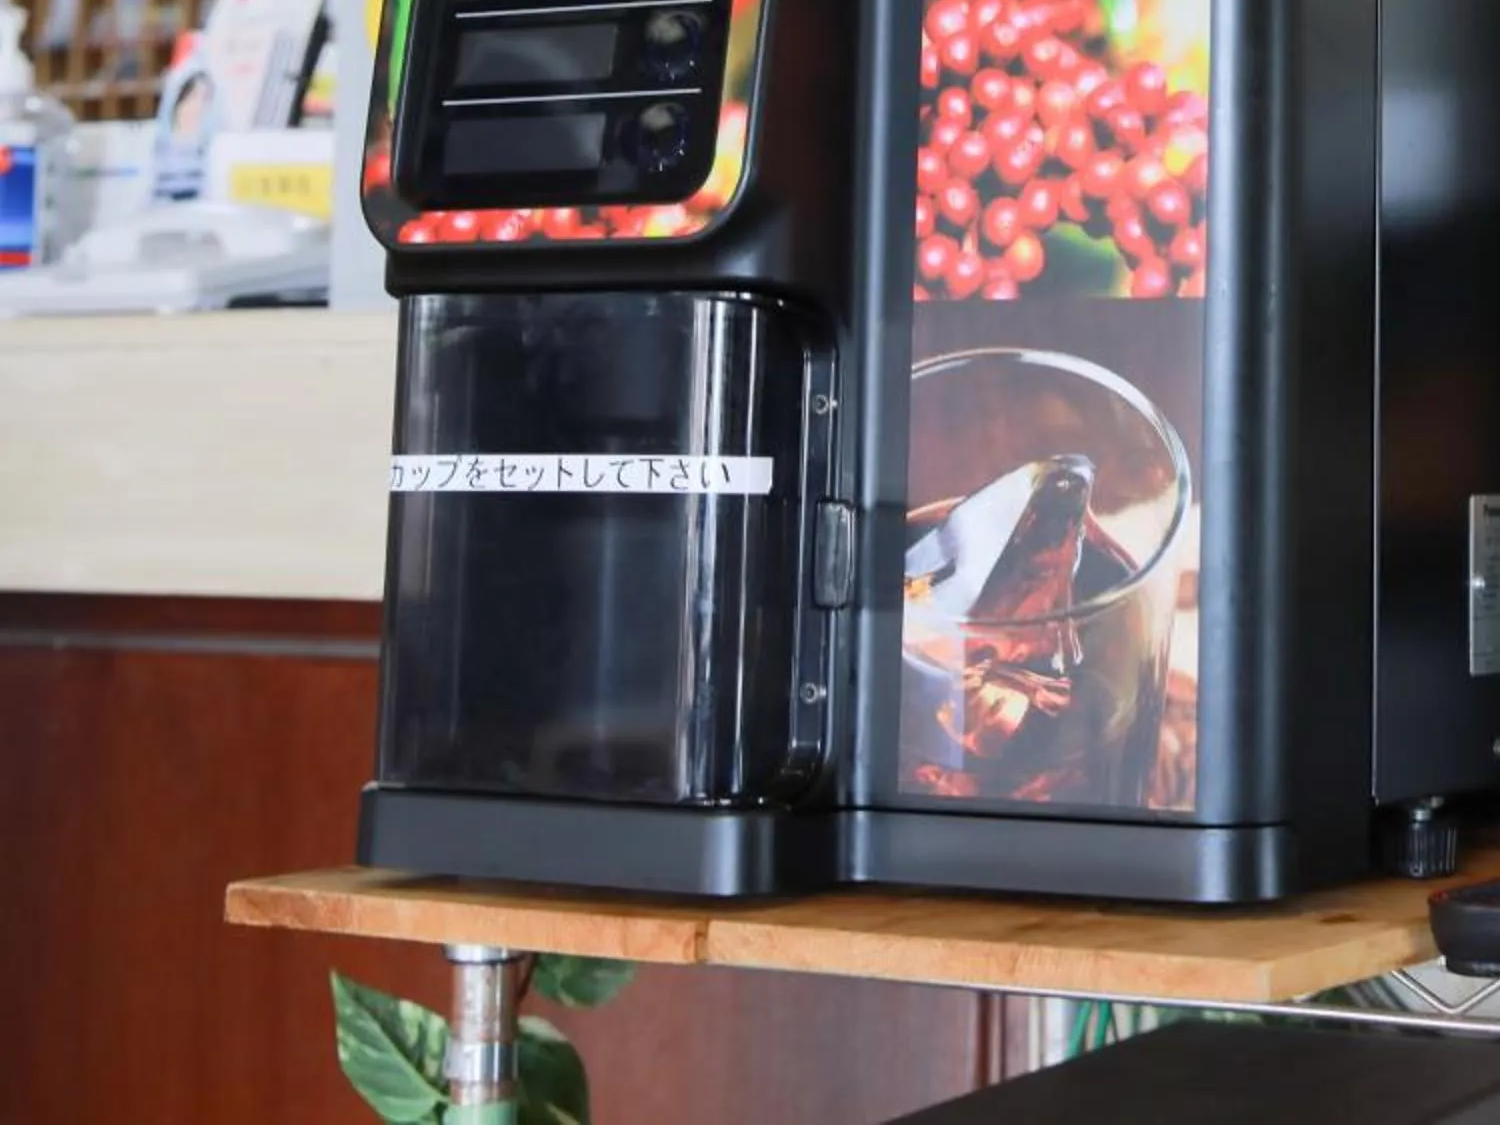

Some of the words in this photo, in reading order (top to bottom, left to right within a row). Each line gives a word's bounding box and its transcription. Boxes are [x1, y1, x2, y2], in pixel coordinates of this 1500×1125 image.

[392, 454, 731, 491] カップをセットして下さい
